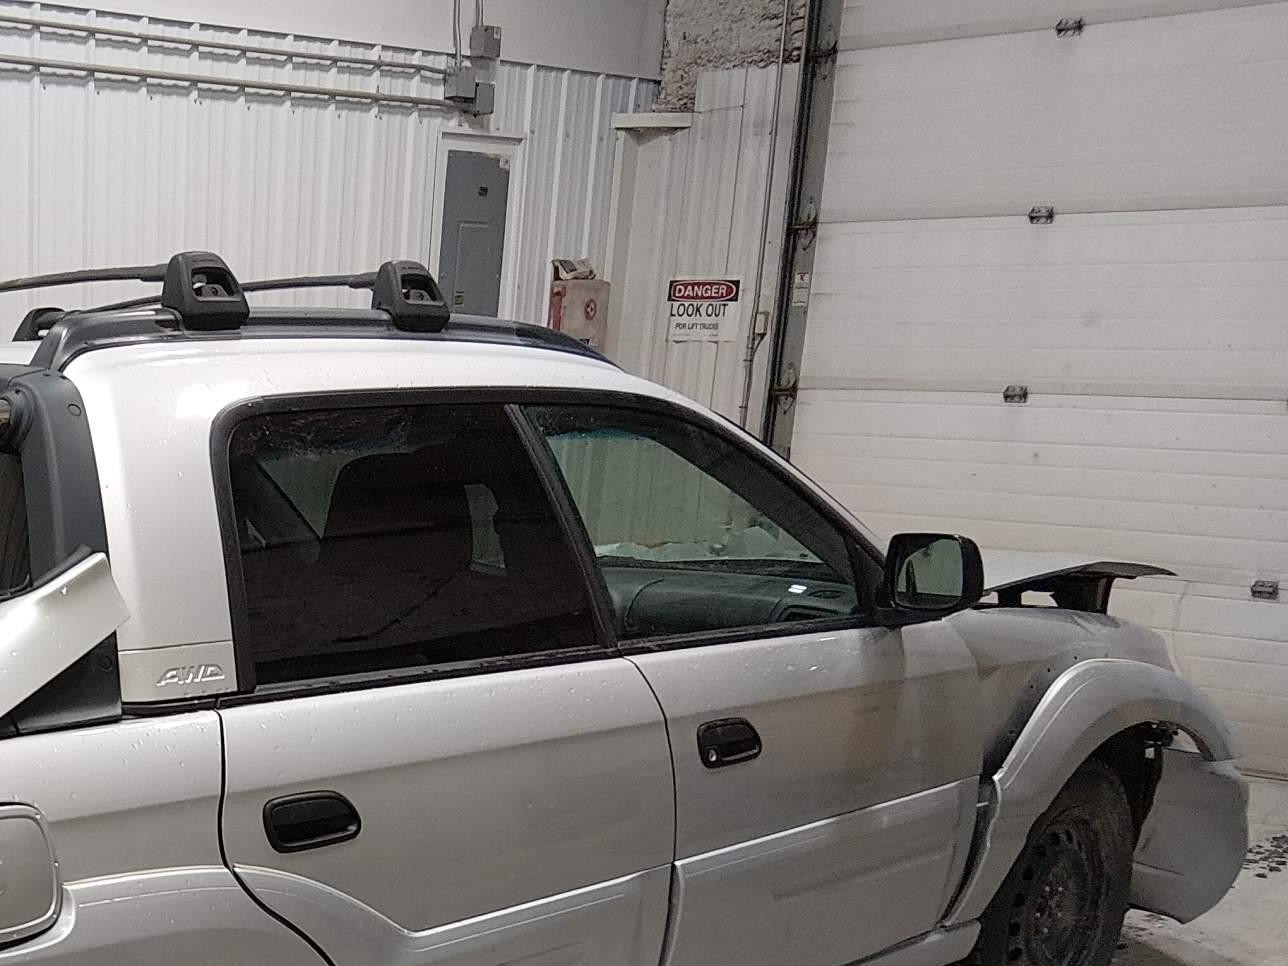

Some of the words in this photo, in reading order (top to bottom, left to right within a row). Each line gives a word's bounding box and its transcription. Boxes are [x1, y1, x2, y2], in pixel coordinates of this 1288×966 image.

[675, 285, 727, 297] DANGER
[670, 303, 704, 317] LOOK
[705, 303, 728, 317] OUT
[156, 664, 225, 687] AWD
